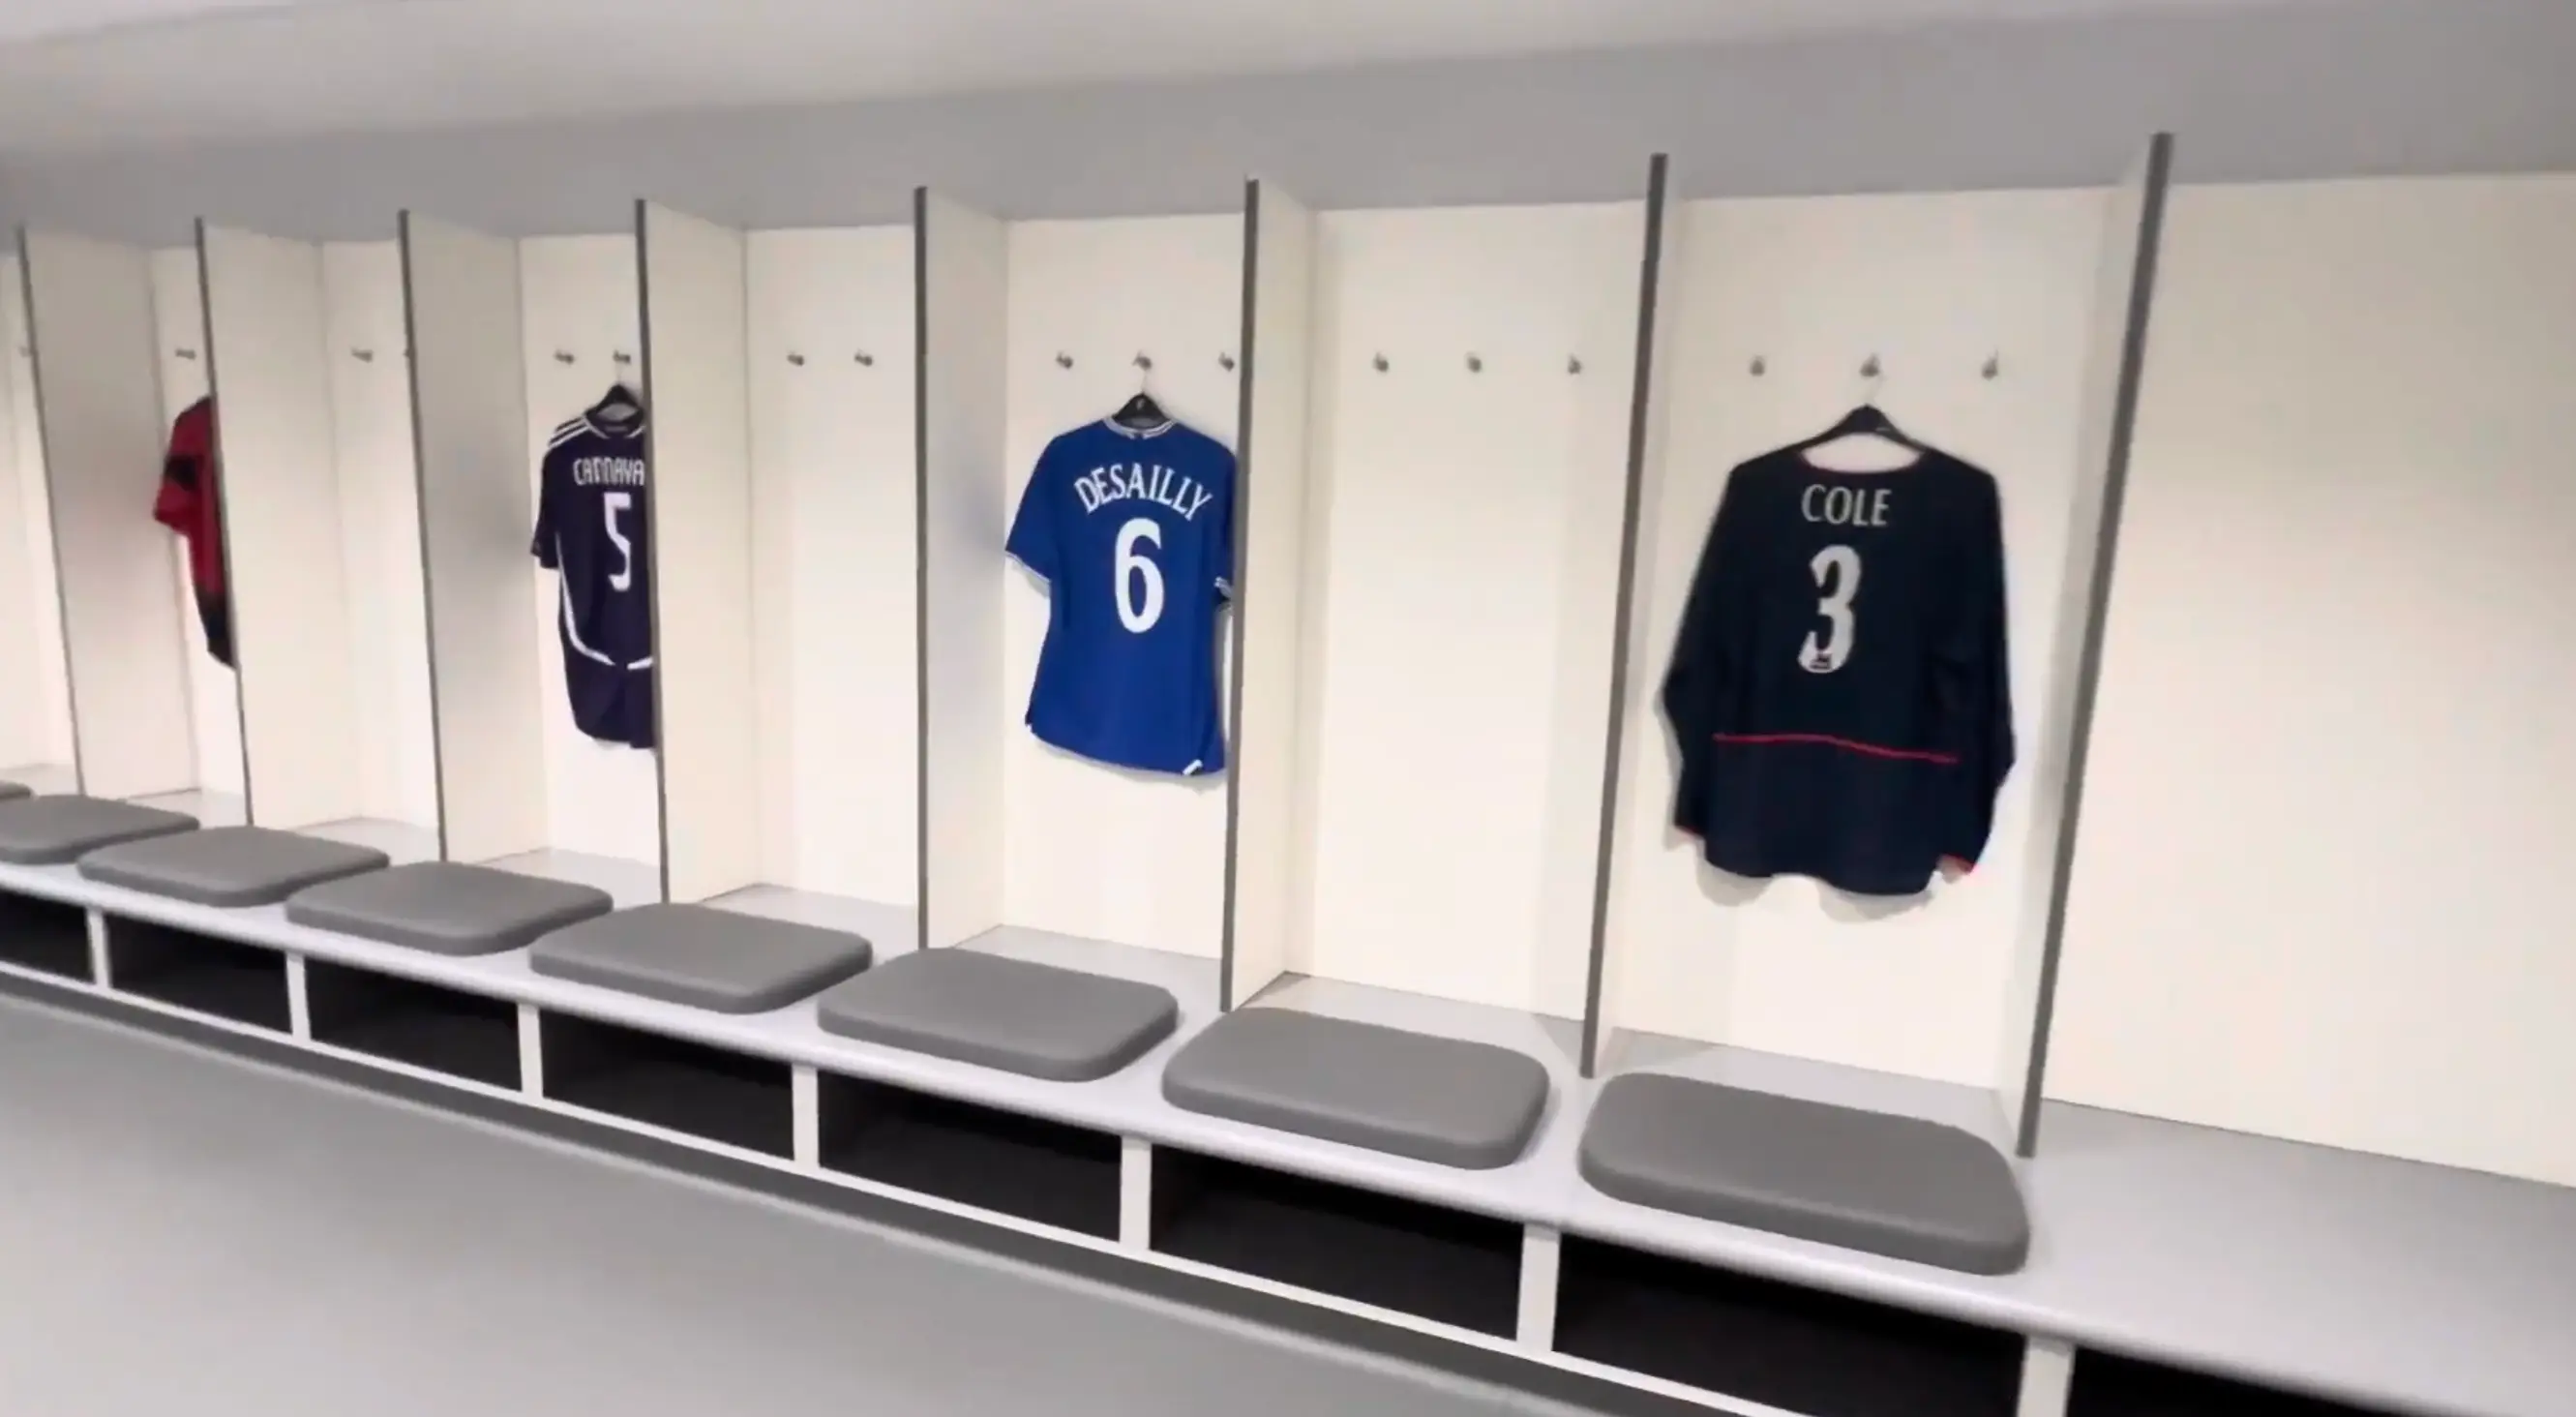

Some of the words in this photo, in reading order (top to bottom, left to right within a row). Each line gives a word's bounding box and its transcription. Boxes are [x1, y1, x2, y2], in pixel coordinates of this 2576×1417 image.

[603, 492, 632, 591] 5
[1073, 464, 1213, 521] DESAILLY
[1801, 484, 1891, 527] COLE
[1114, 517, 1164, 633] 6
[1797, 544, 1862, 674] 3
